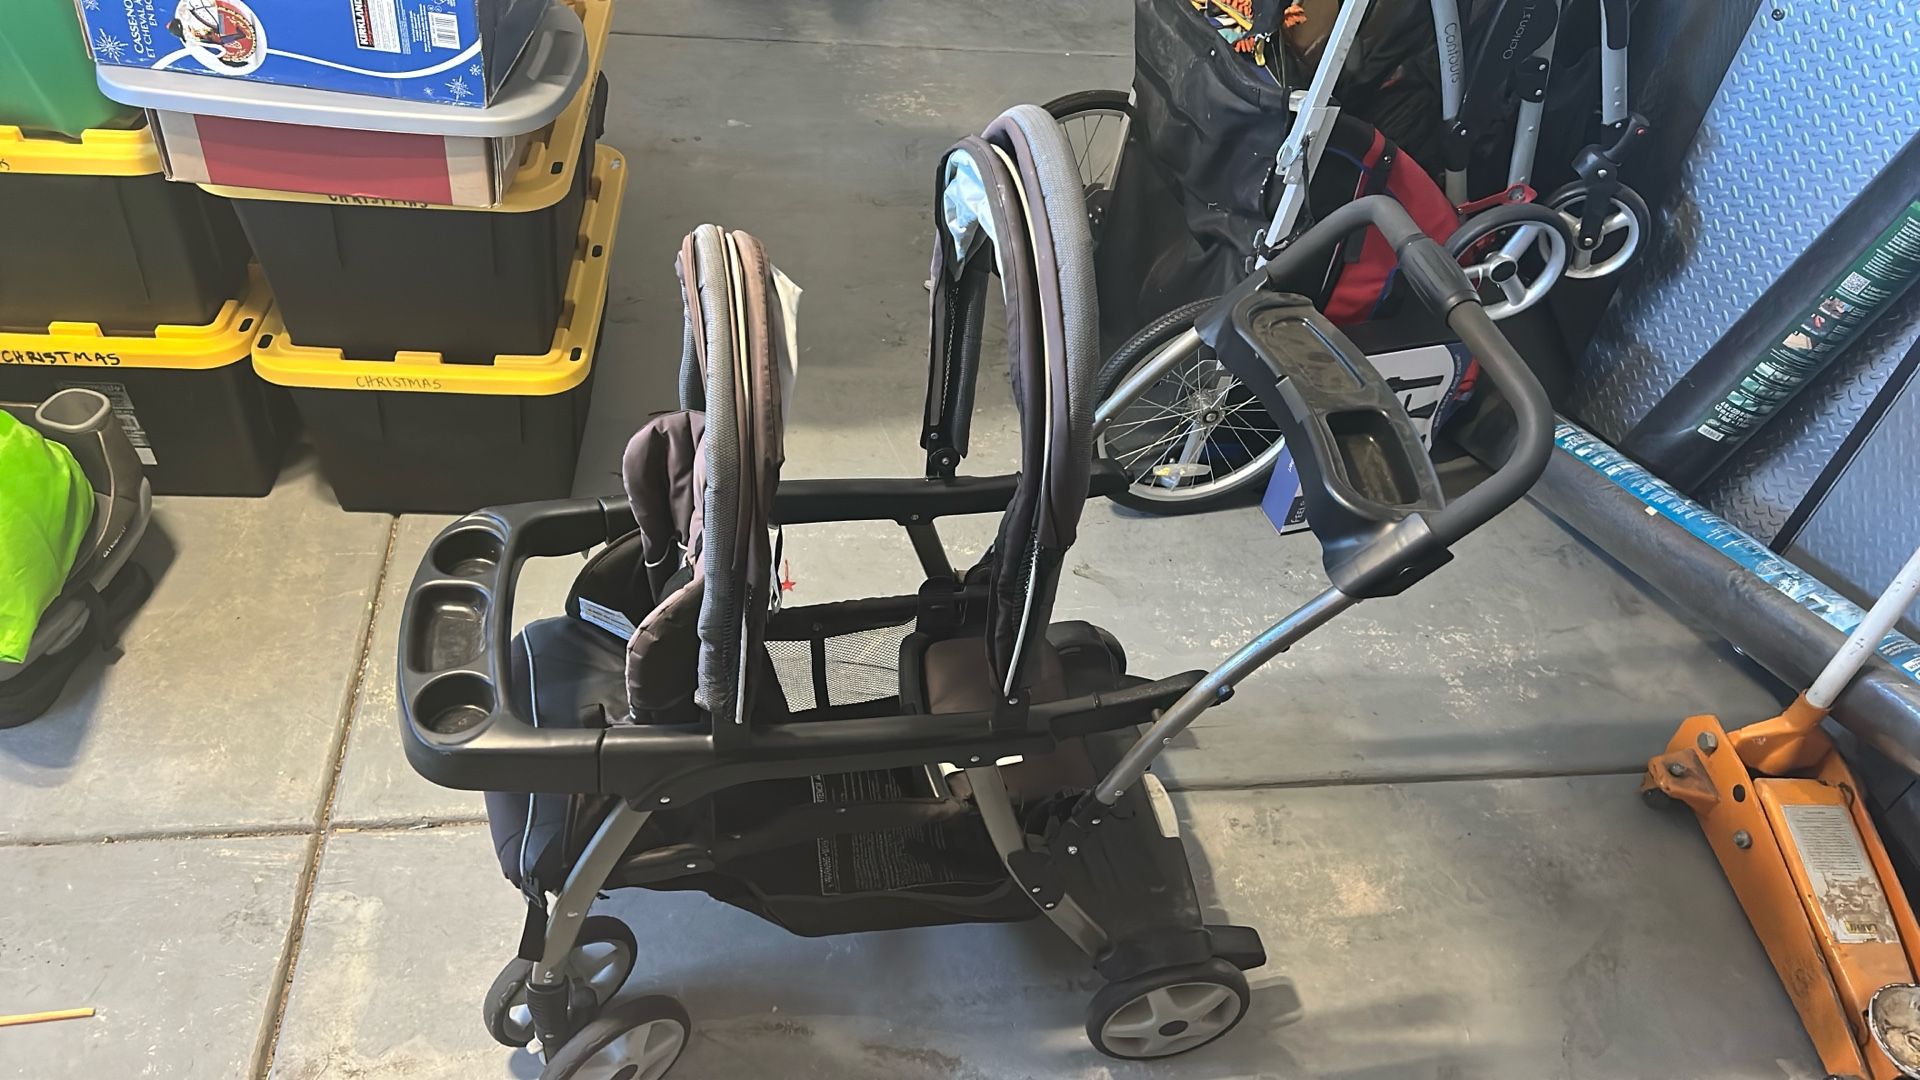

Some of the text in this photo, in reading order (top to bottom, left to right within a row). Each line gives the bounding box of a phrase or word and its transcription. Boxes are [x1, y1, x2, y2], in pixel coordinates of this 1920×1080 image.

[136, 8, 152, 45] CHEVAL
[147, 13, 158, 27] EN
[145, 45, 156, 58] ET
[1444, 22, 1460, 84] Contours
[1, 350, 120, 366] CHRISTMAS
[356, 375, 442, 390] CHRISTMAS
